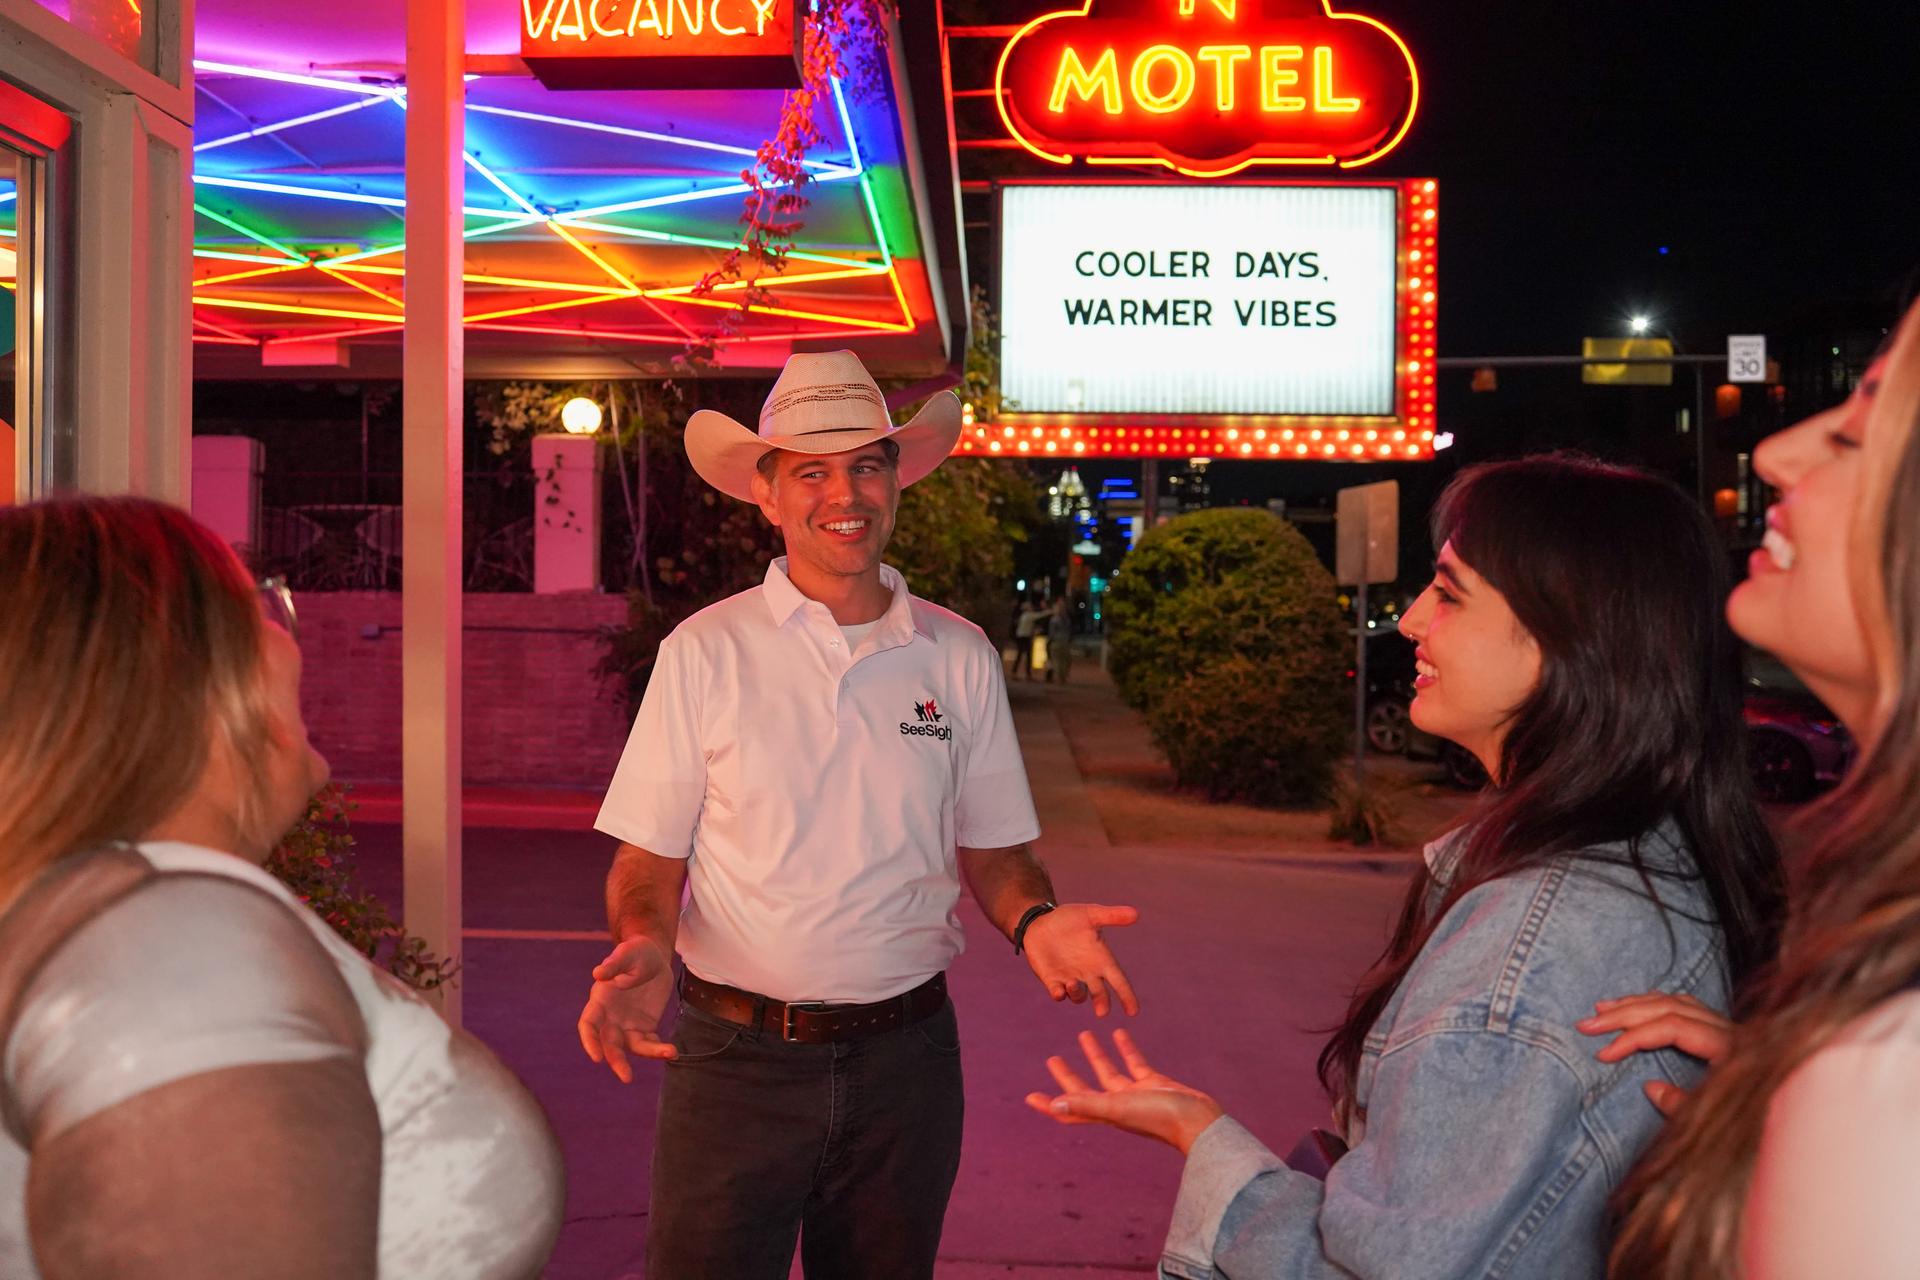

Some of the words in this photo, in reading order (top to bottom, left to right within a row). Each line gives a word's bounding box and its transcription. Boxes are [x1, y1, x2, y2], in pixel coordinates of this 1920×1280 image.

[1048, 44, 1361, 114] MOTEL
[1075, 251, 1209, 278] COOLER
[1064, 299, 1213, 326] WARMER
[1234, 300, 1337, 327] VIBES
[1734, 358, 1760, 376] 30
